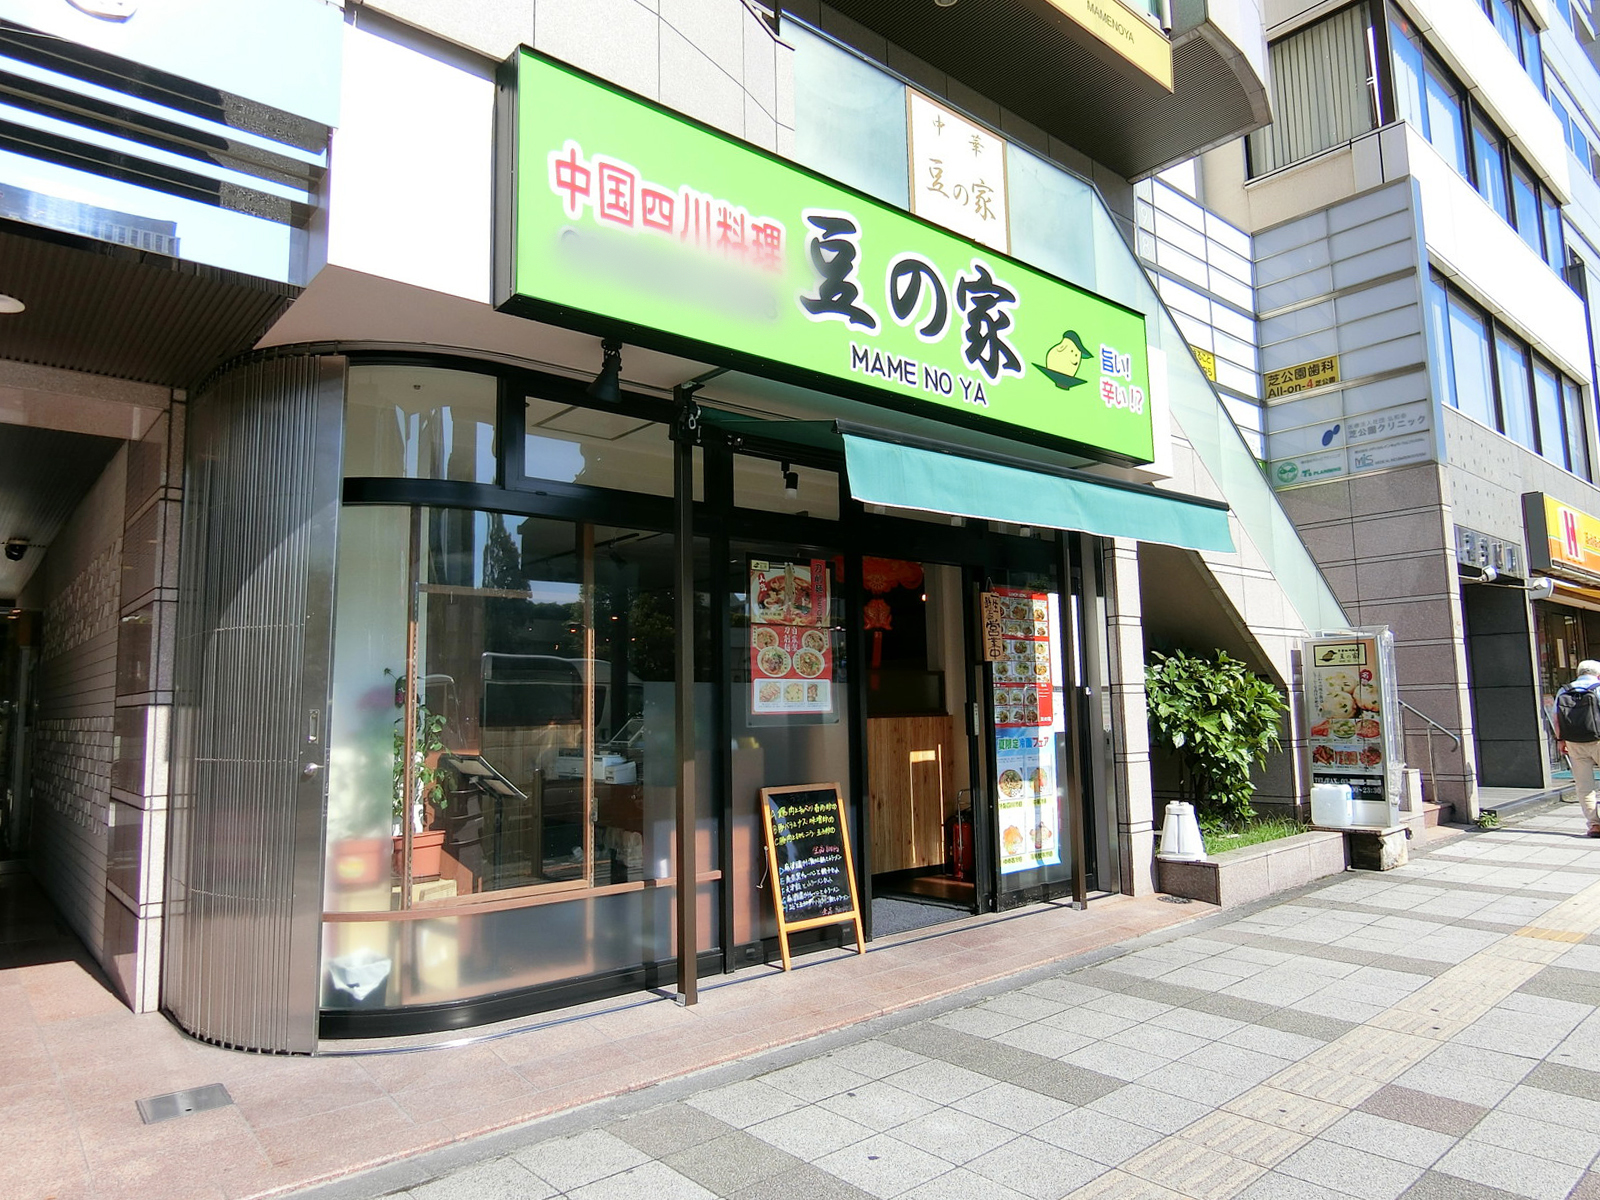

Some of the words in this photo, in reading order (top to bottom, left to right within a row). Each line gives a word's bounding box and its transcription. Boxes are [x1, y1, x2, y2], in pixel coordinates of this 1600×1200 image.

[1086, 0, 1134, 44] MAMENOYA
[554, 147, 783, 275] 中国四川料理
[926, 157, 997, 221] 豆の家
[800, 215, 1022, 379] 豆の家
[851, 343, 917, 385] MAME
[924, 365, 953, 395] NO
[959, 376, 987, 405] YA
[1267, 359, 1335, 388] 芝公園歯科
[1267, 378, 1314, 399] All-on-4
[1348, 415, 1426, 439] 芝公園クリニック
